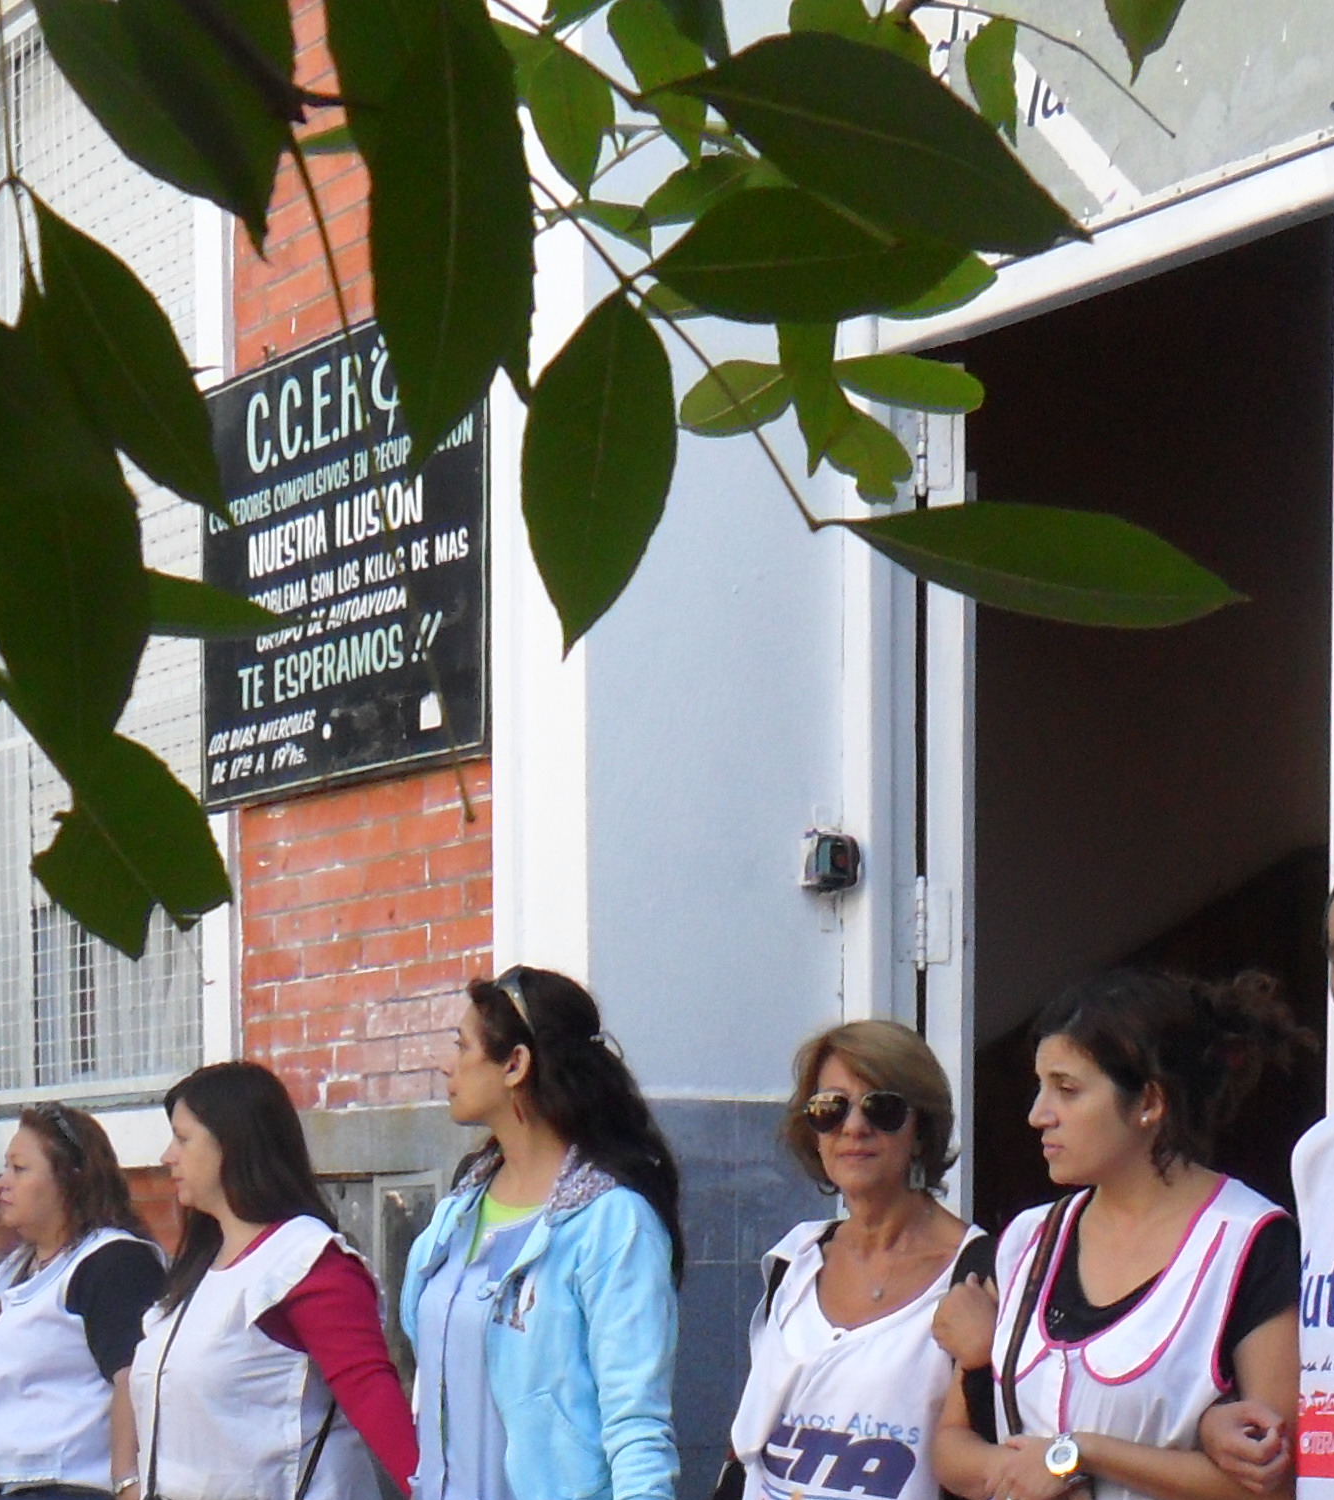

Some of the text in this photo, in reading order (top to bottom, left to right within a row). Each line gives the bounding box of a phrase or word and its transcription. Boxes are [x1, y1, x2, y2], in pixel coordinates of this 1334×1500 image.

[209, 489, 272, 536] CEDORES
[273, 458, 350, 512] COMPULSIVOS
[353, 449, 368, 483] EN
[248, 509, 328, 579] NUESTRA
[248, 526, 469, 615] OBLEMA SON LOS KILOS DE MAS
[326, 586, 407, 630] AUTOAYUDA
[238, 663, 265, 711] TE
[274, 623, 405, 703] ESPERAMOS
[208, 730, 230, 756] LOS
[229, 723, 257, 751] DIAS
[211, 760, 228, 785] DE
[254, 752, 265, 774] A
[761, 1424, 917, 1500] CTA
[845, 1411, 920, 1445] Aires
